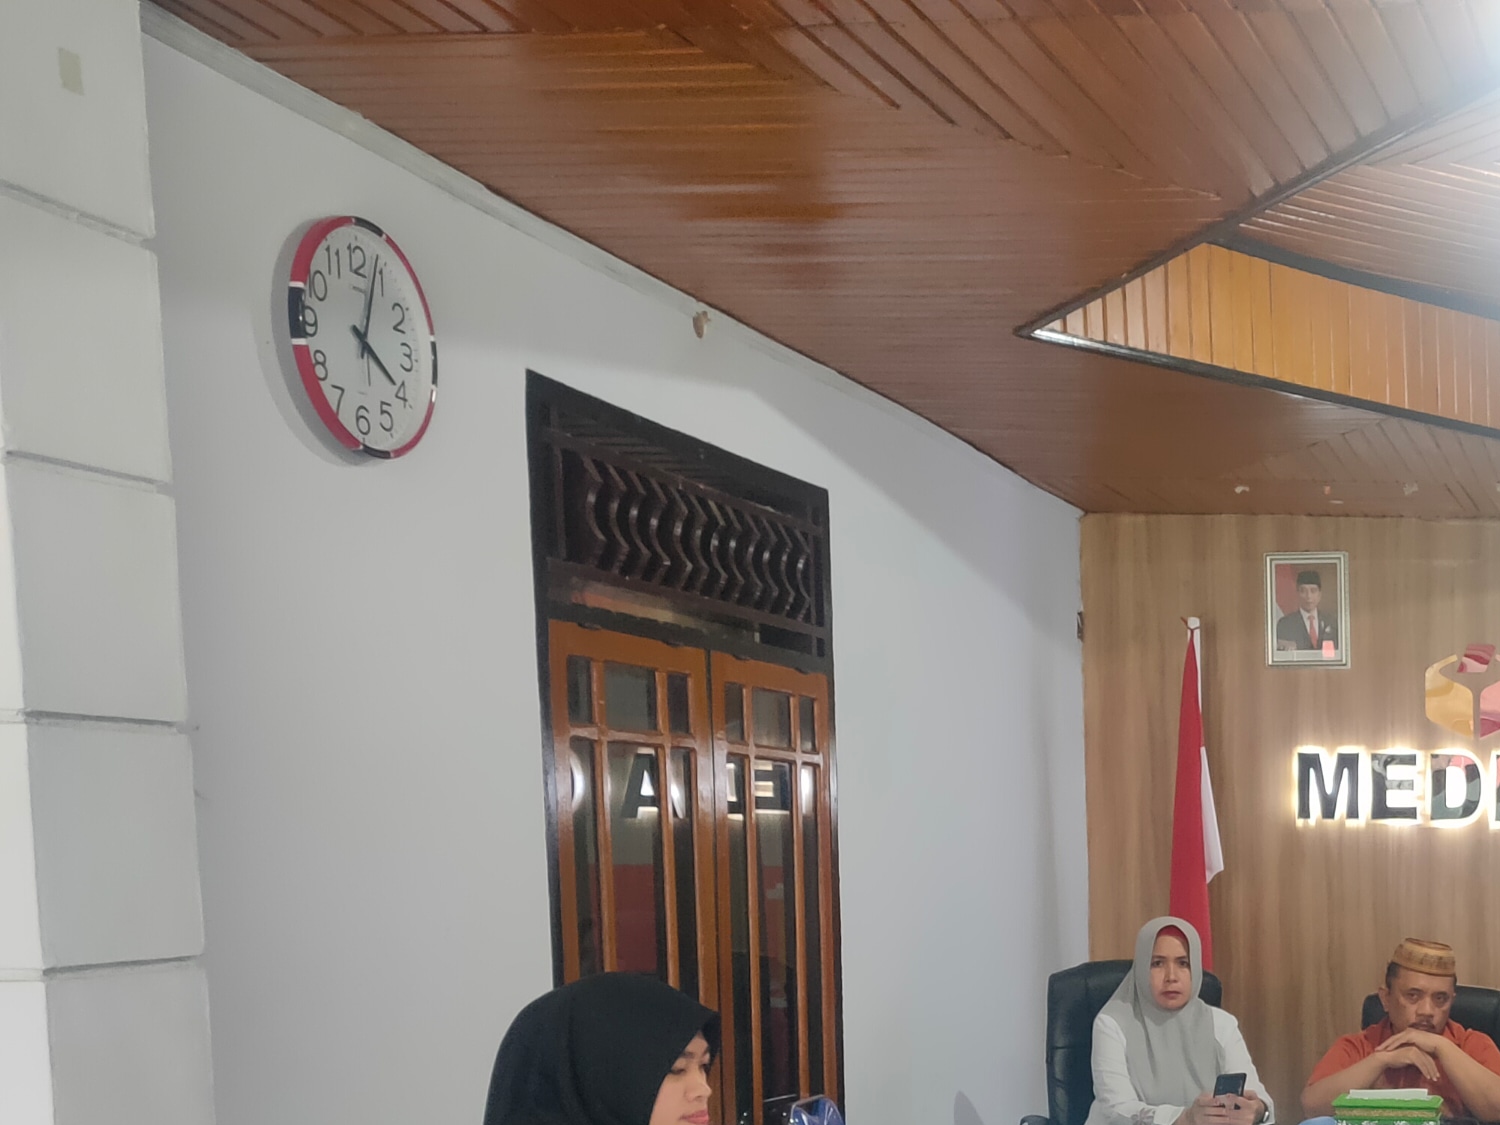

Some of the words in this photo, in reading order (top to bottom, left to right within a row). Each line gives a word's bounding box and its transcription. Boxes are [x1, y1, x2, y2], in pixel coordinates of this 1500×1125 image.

[325, 245, 341, 279] 11
[347, 243, 367, 278] 12
[308, 269, 328, 302] 10
[304, 305, 319, 337] 9
[392, 303, 406, 334] 2
[313, 350, 328, 381] 8
[400, 342, 414, 372] 3
[331, 384, 345, 417] 7
[395, 380, 409, 408] 4
[355, 405, 371, 436] 6
[379, 400, 394, 433] 5
